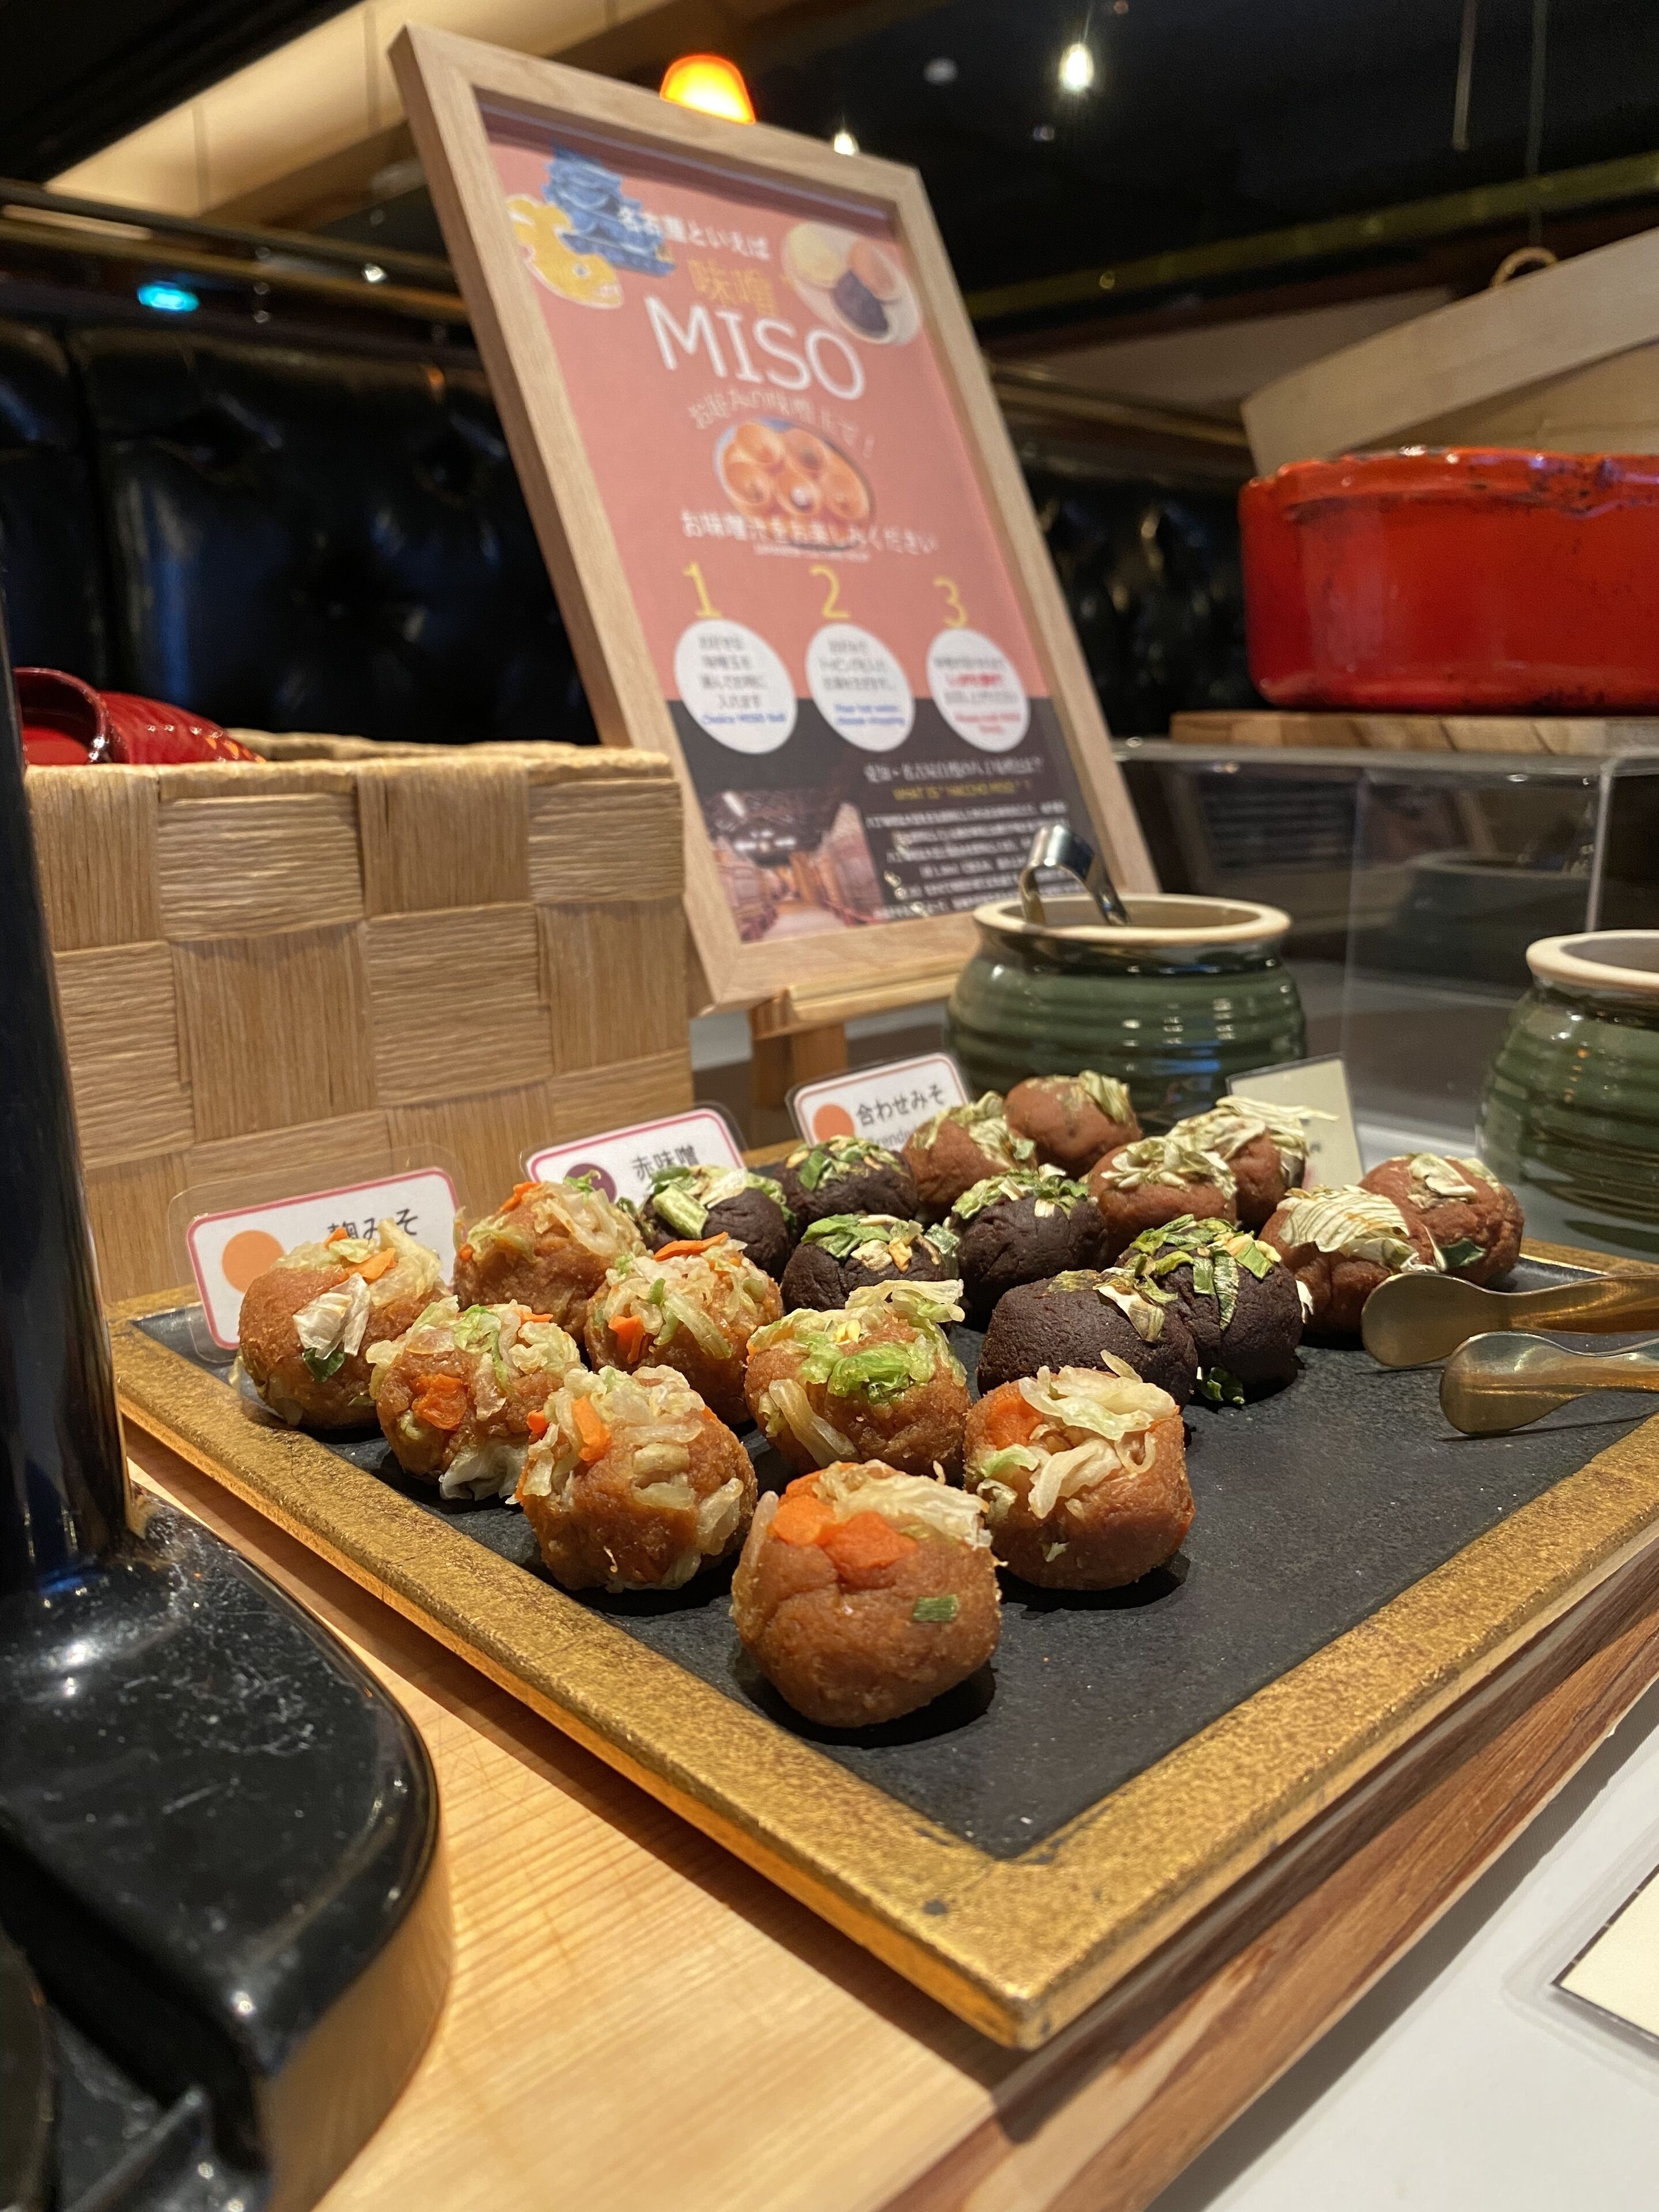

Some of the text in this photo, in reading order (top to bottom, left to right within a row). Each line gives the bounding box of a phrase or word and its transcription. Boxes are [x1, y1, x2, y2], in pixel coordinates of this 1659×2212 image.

[645, 297, 865, 400] MISO
[683, 562, 722, 618] 1
[810, 565, 850, 619] 2
[933, 577, 968, 627] 3
[857, 1084, 945, 1126] 合わせみそ
